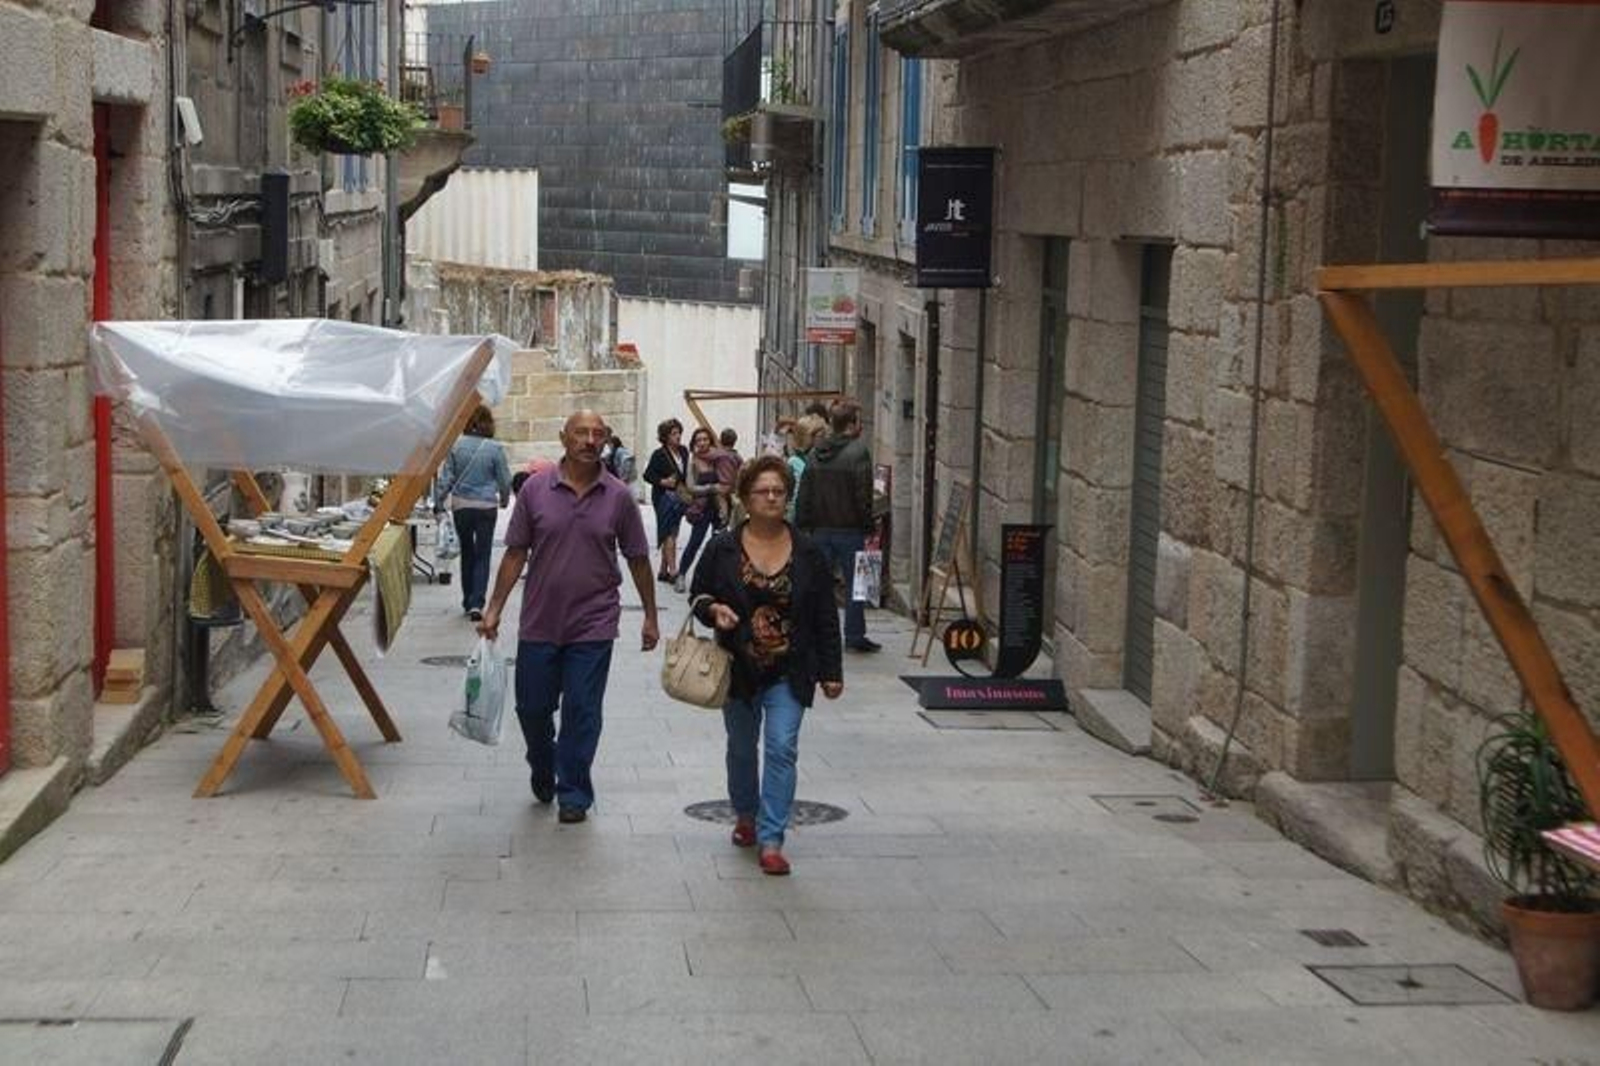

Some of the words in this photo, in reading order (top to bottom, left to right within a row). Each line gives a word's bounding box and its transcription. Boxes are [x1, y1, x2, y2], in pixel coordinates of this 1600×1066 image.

[1452, 130, 1474, 149] A
[1501, 155, 1522, 166] DE
[949, 628, 981, 650] 10
